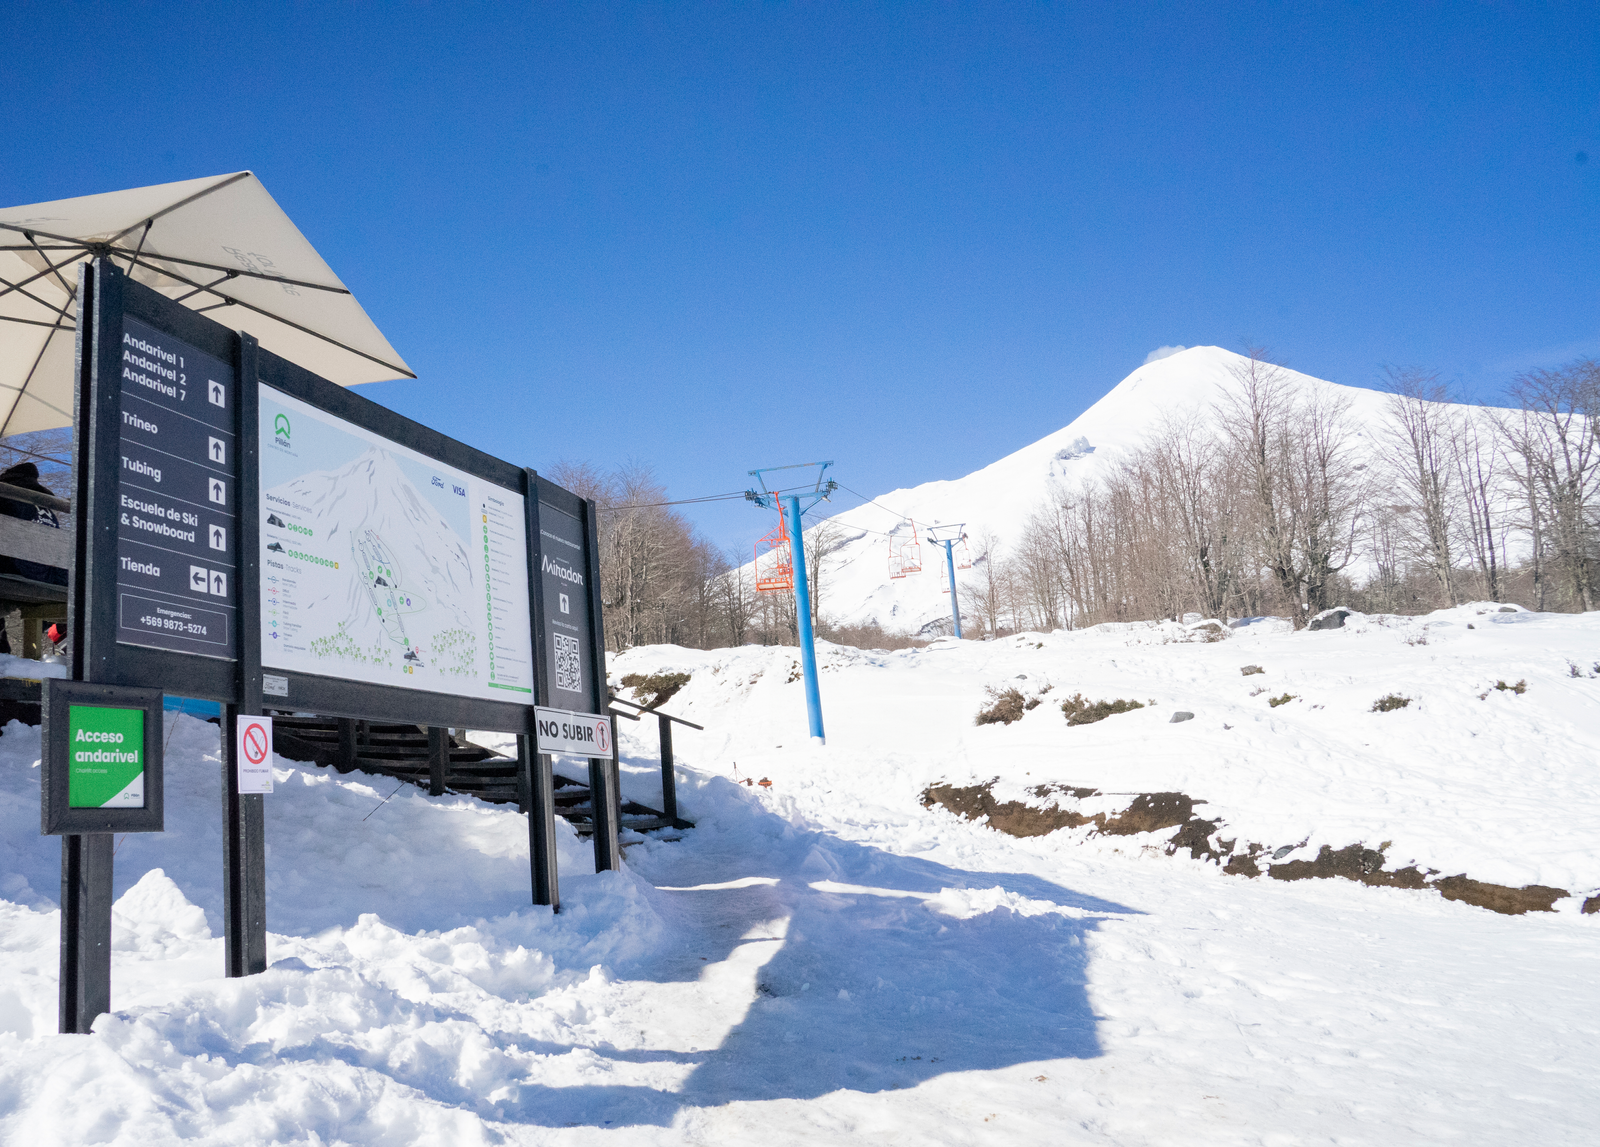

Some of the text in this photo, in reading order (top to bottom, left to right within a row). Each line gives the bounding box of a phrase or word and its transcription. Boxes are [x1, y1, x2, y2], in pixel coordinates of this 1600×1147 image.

[123, 332, 184, 369] Andarivel 1
[122, 349, 187, 386] Andarivel 2
[122, 367, 187, 401] Andarivel 7
[122, 411, 159, 434] Trineo
[121, 456, 162, 482] Tubing
[265, 493, 291, 507] Servicios
[451, 484, 466, 497] VISA
[120, 494, 198, 527] Escuela de Ski
[120, 512, 195, 543] & Snowboard
[120, 556, 161, 577] Tienda
[267, 559, 284, 570] Pistas
[541, 554, 584, 586] Mirador
[156, 607, 192, 620] Emergencias:
[140, 615, 207, 636] +569 9873-5274
[75, 728, 124, 743] Acceso
[539, 719, 595, 743] NO SUBIR
[75, 748, 139, 763] andarivel
